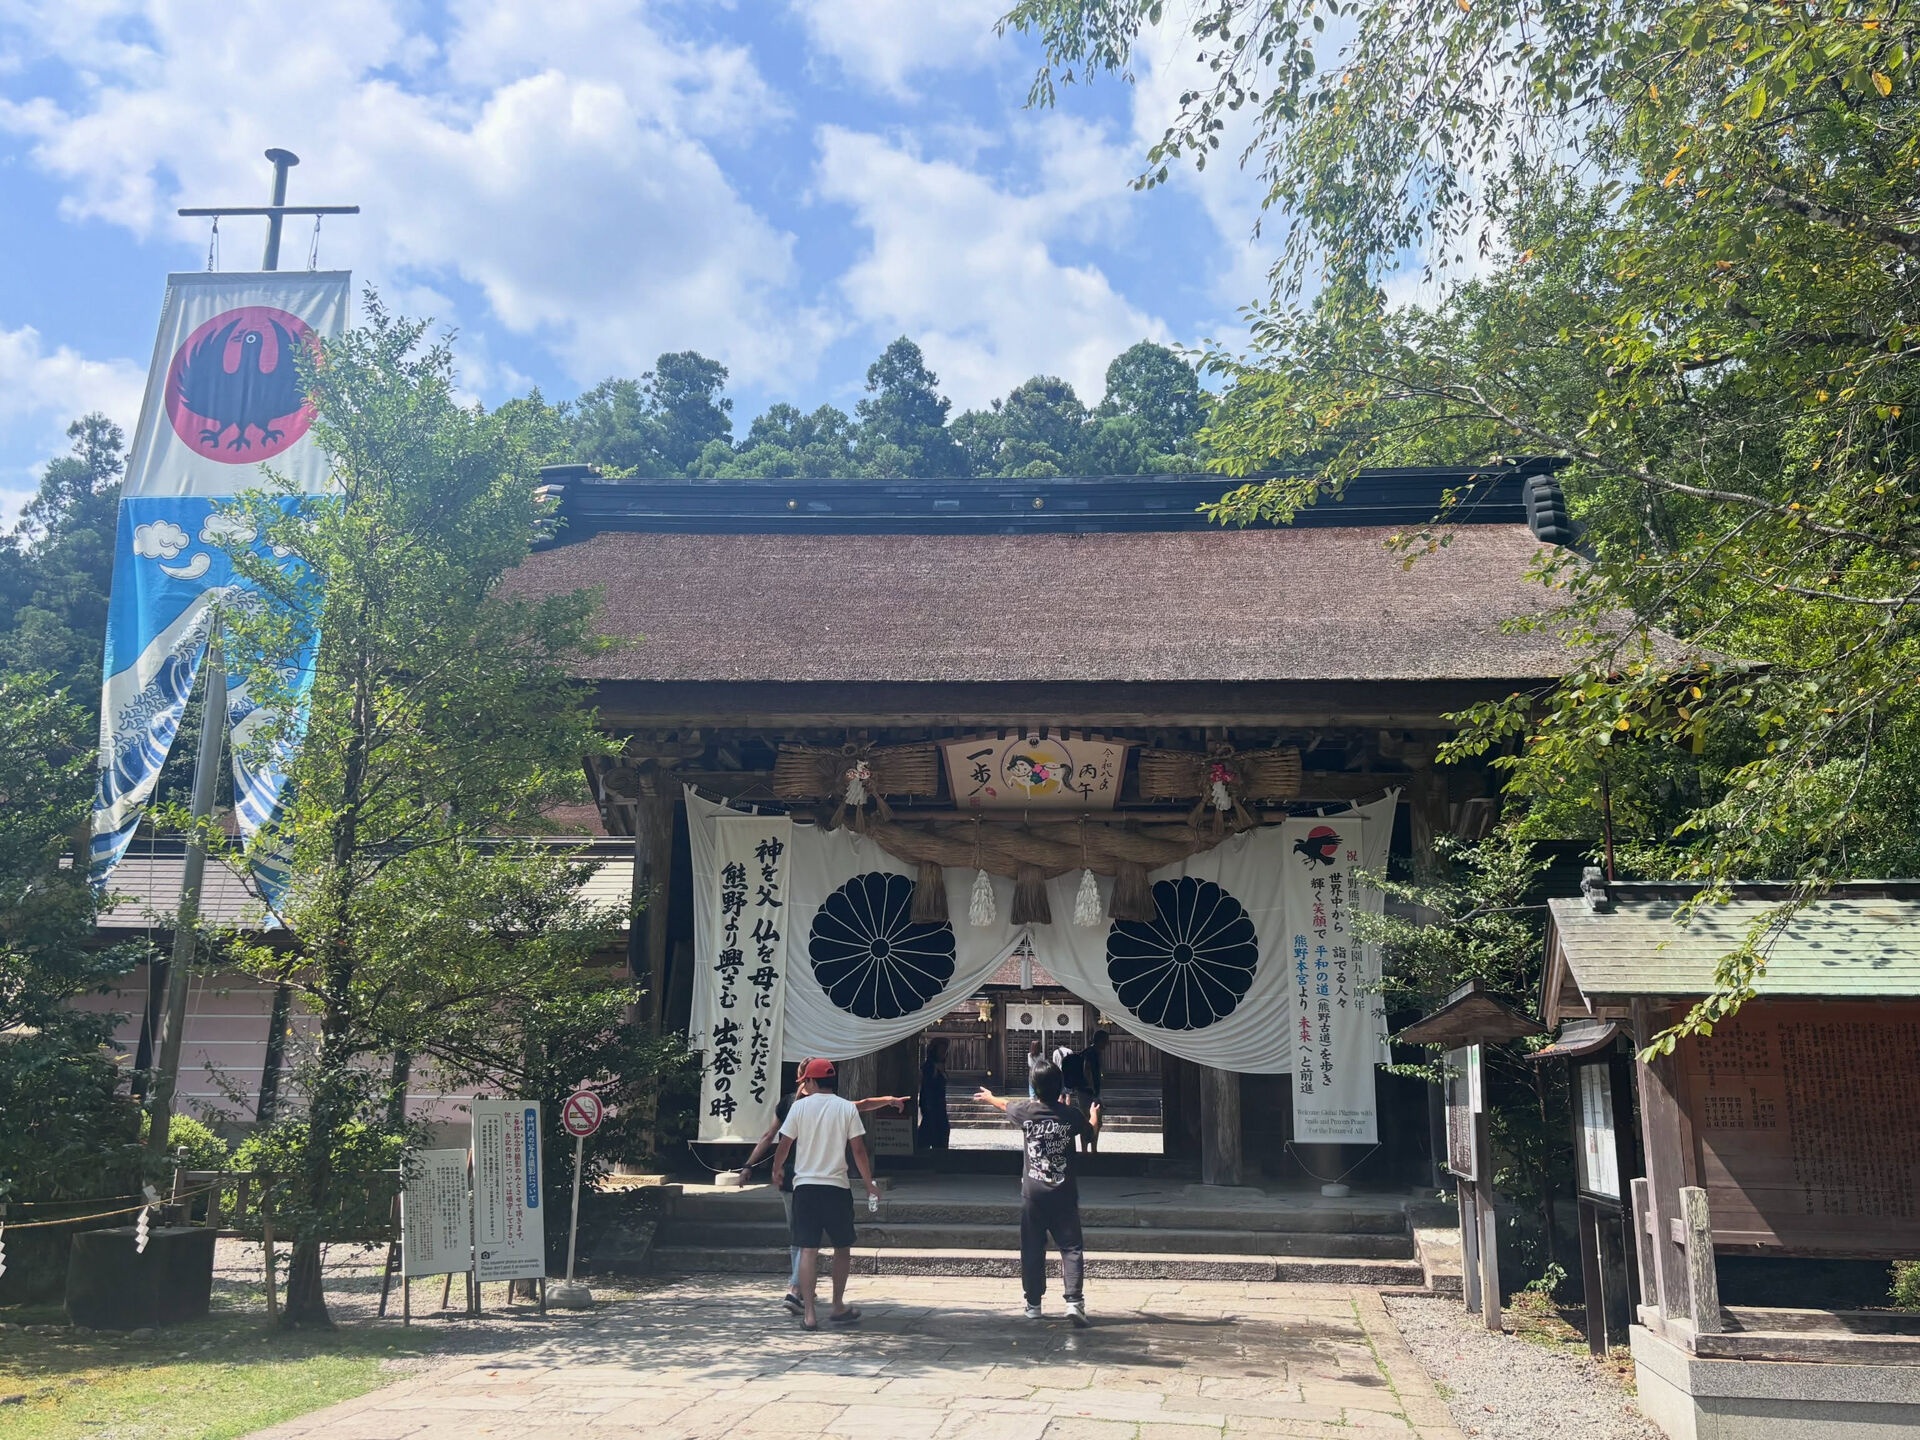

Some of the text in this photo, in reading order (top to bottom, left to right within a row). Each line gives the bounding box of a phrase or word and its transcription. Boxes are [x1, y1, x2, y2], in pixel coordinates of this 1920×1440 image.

[967, 748, 994, 796] 一歩
[1078, 763, 1097, 800] 丙午
[1346, 849, 1358, 862] 祝
[1310, 876, 1327, 940] 輝く笑顔で
[1328, 871, 1349, 1010] 世界中から 詣でる人々
[709, 860, 749, 1123] 熊野より興さむ 出発の時
[747, 835, 784, 1104] 神を父 仏を母に いただきて
[1293, 933, 1314, 1095] 熊野本宮より 未来へと前進
